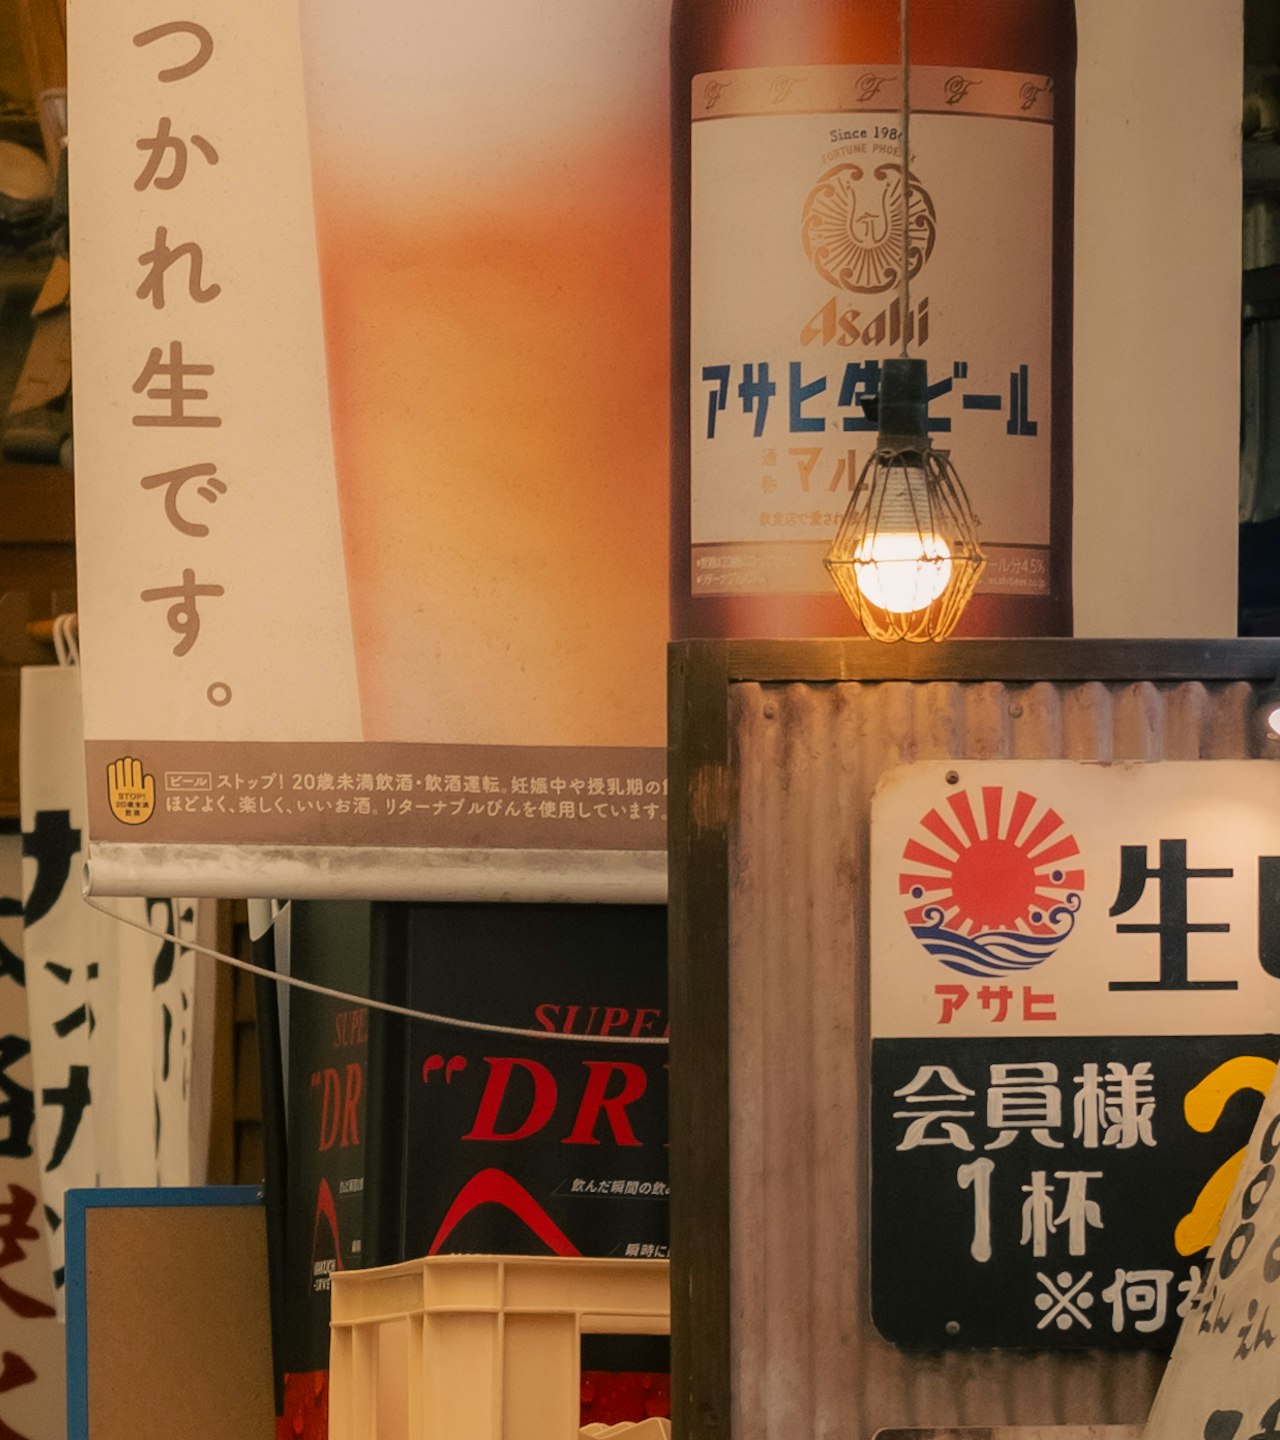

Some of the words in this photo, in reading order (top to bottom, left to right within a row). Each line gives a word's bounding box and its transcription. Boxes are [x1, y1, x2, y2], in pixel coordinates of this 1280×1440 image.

[830, 127, 868, 143] Since
[800, 296, 929, 348] Asahi
[169, 776, 209, 789] ビール
[217, 772, 285, 792] ストップ!
[1107, 838, 1280, 993] 生
[533, 1003, 669, 1040] SUPE
[934, 983, 1058, 1024] アサヒ
[892, 1061, 1158, 1151] 会員様
[956, 1156, 1105, 1263] 1杯
